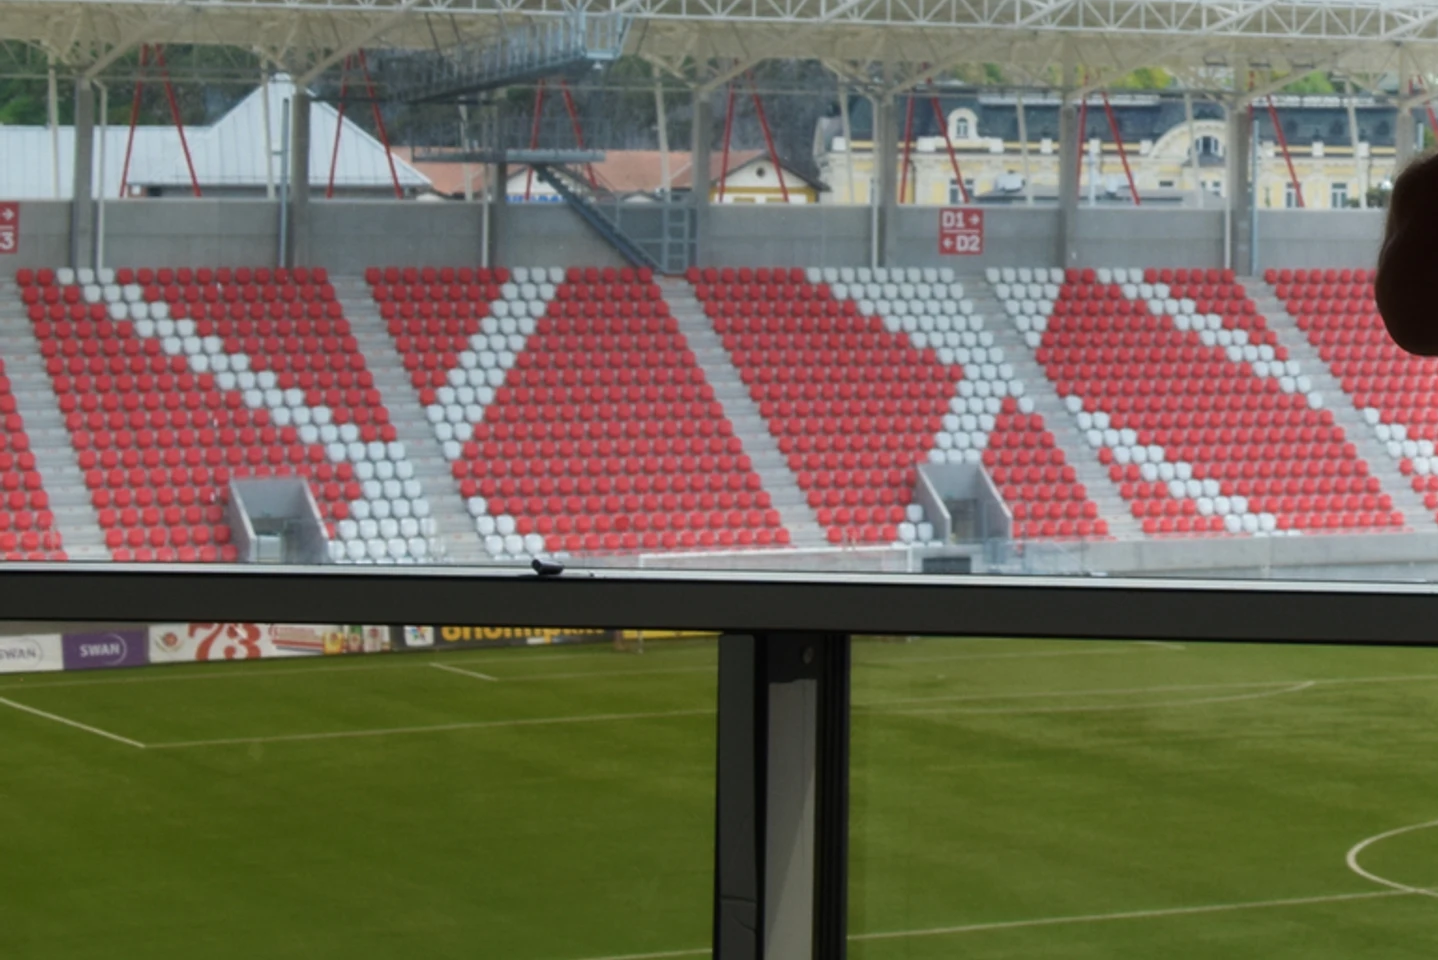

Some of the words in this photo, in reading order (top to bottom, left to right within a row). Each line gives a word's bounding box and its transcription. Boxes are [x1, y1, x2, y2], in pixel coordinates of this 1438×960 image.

[942, 211, 965, 228] D1
[956, 235, 980, 252] D2
[79, 643, 120, 658] SWAN
